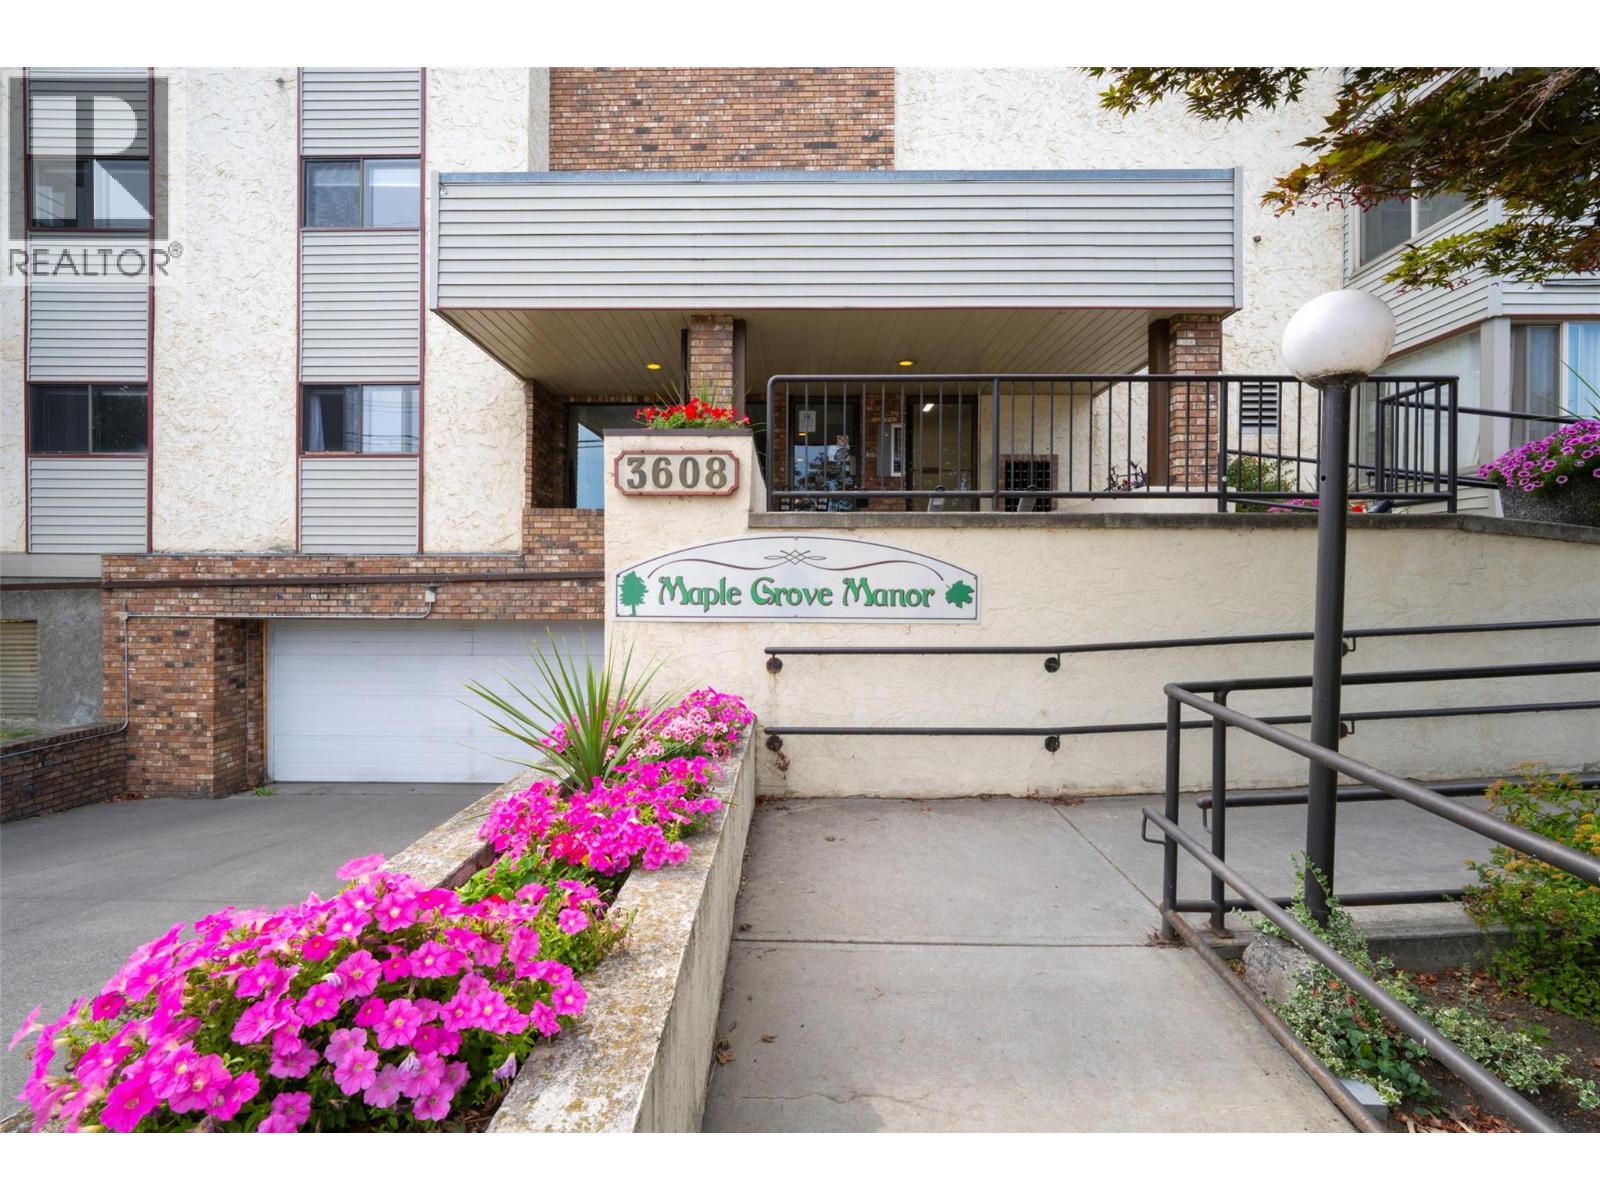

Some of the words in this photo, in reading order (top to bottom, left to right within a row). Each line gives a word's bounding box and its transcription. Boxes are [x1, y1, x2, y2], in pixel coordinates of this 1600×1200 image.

[626, 456, 728, 489] 3608
[658, 576, 742, 613] Maple
[750, 576, 833, 607] Grove
[842, 577, 935, 608] Manor
